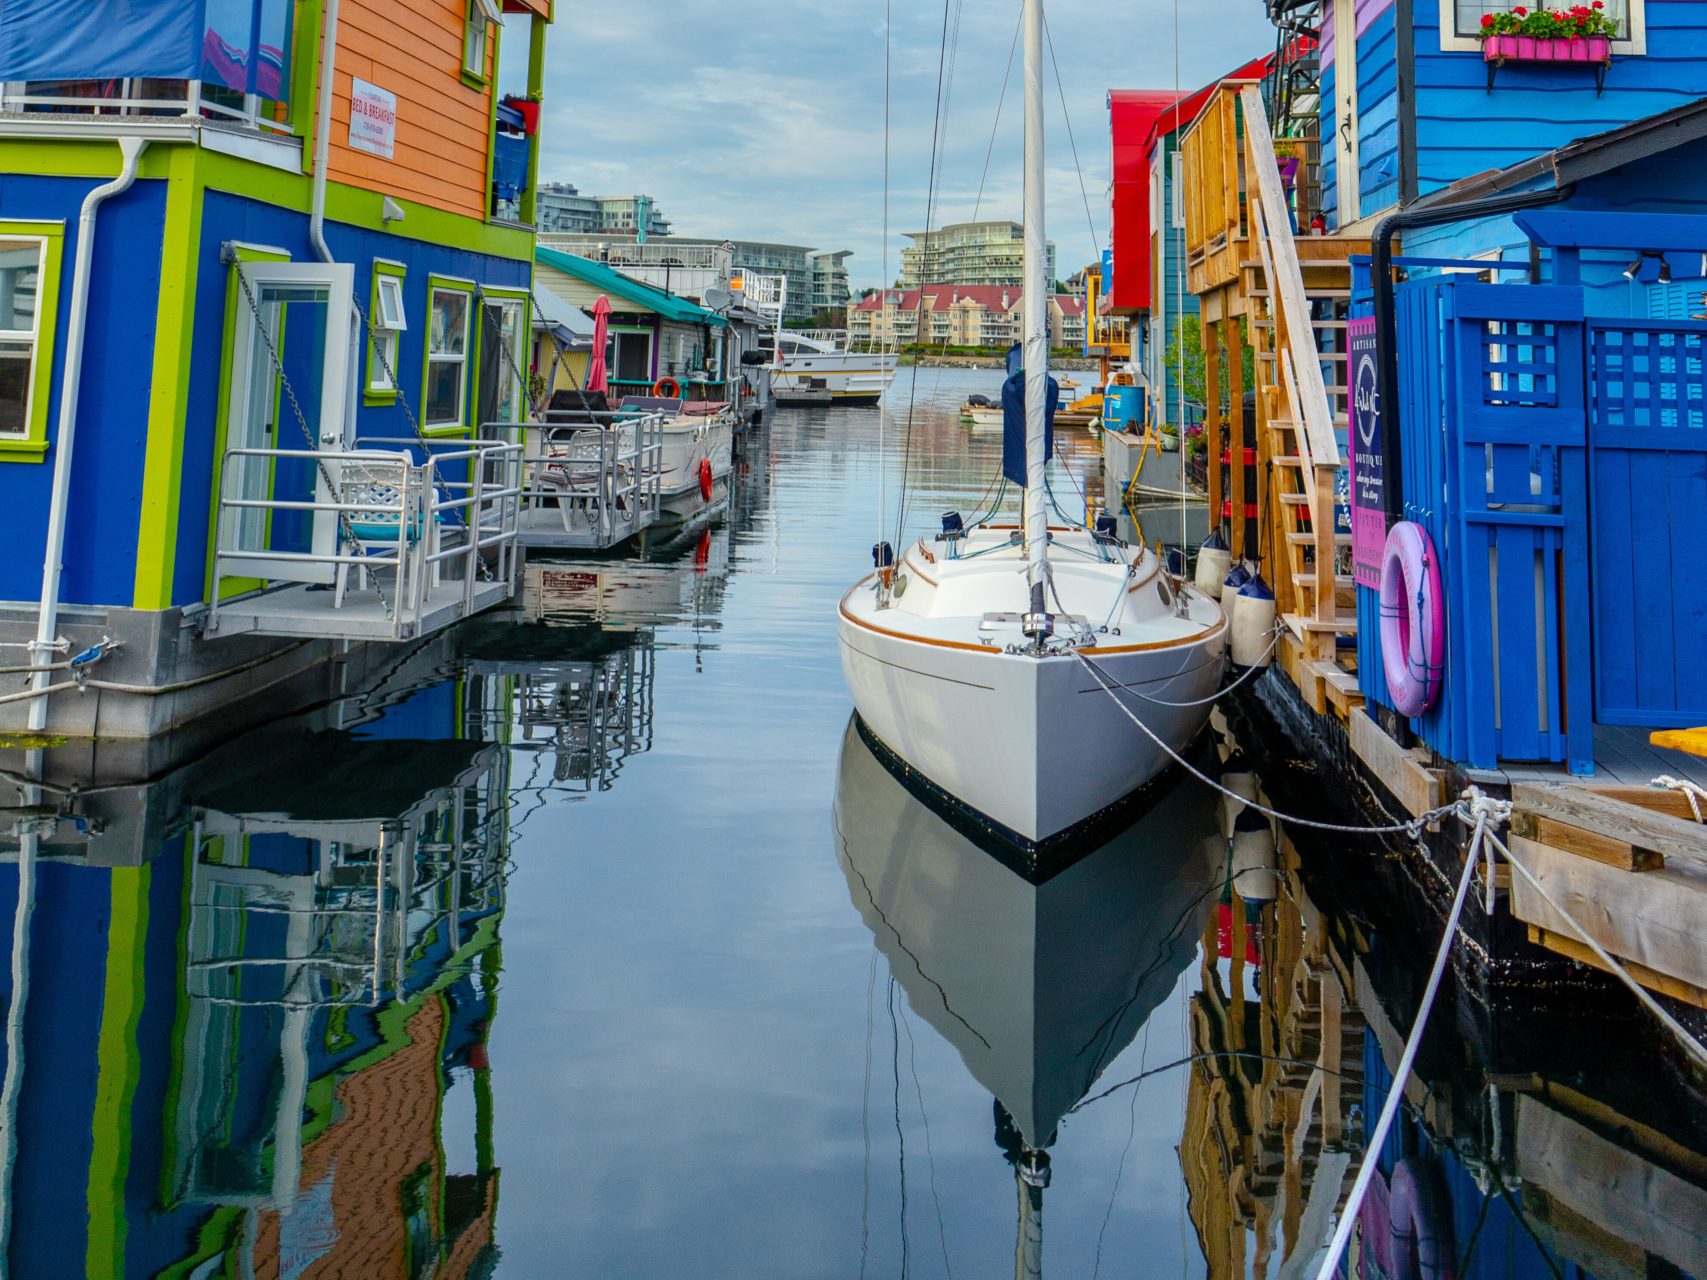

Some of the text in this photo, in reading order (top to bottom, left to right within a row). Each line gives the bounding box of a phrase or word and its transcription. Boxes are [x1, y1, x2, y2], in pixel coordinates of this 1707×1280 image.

[352, 98, 395, 124] BED & BREAKFAST
[1353, 338, 1376, 350] ARTISAN
